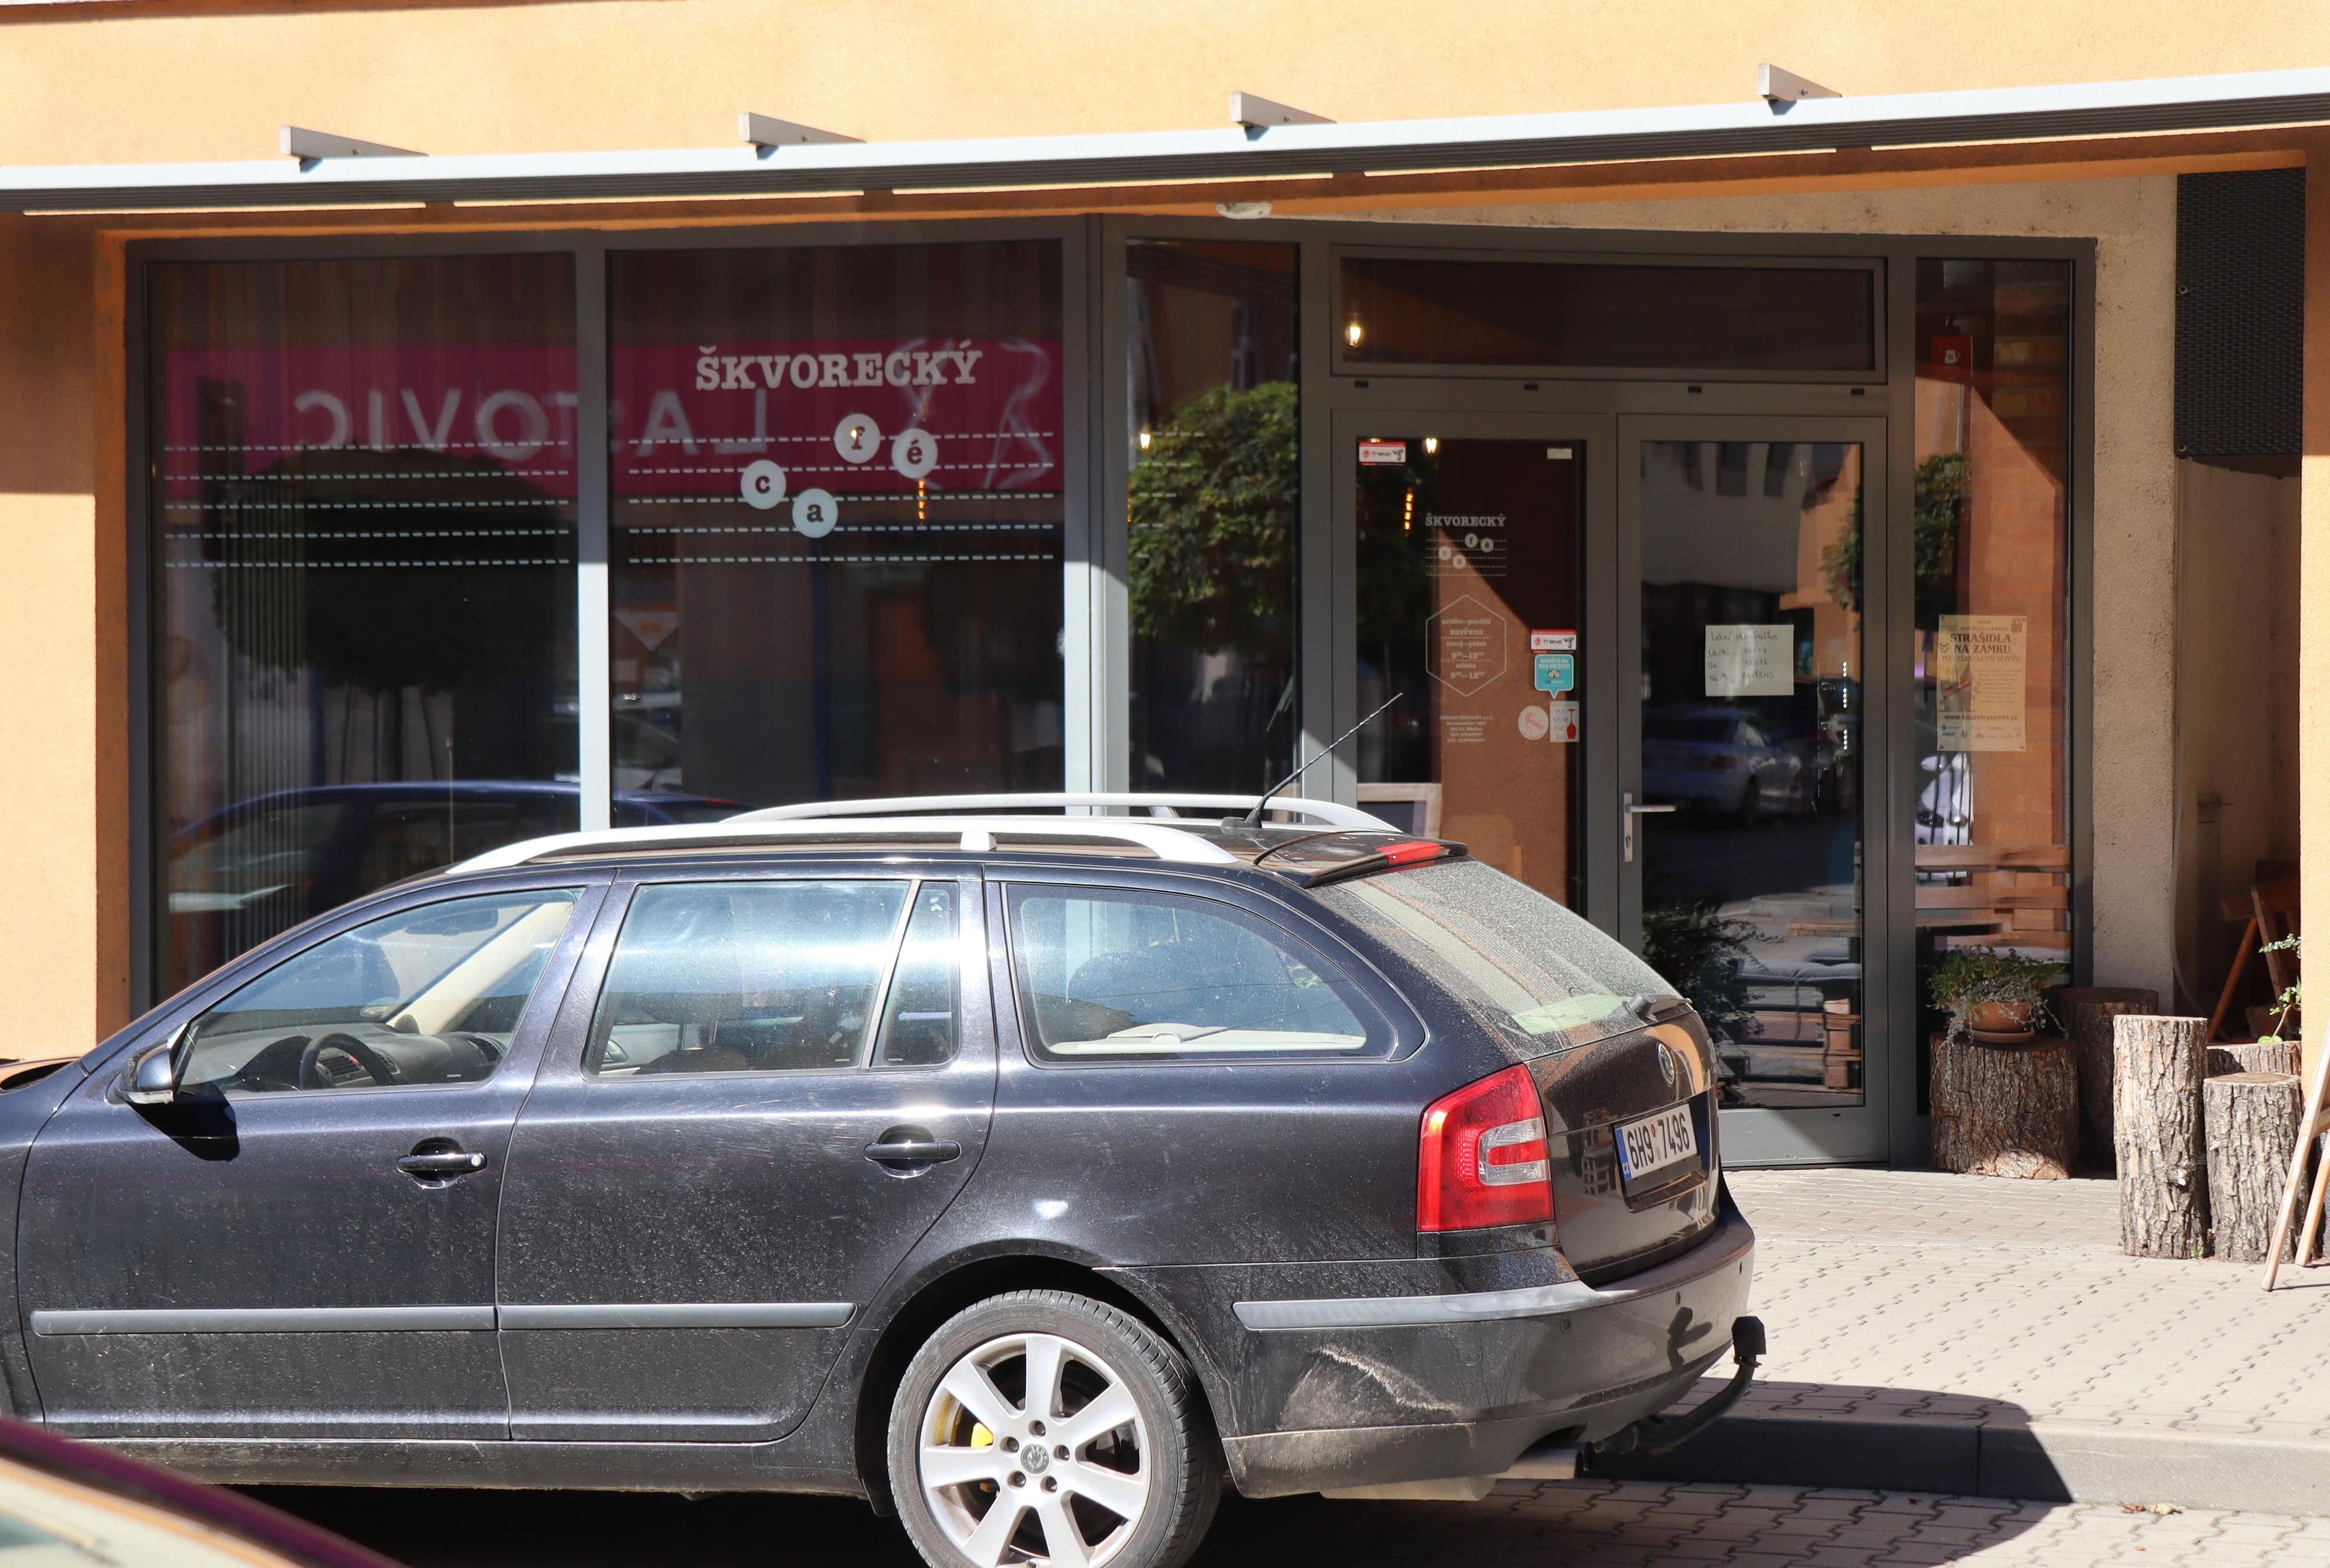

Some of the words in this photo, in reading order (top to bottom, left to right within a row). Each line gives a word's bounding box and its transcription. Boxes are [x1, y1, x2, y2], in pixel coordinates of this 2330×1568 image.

[696, 341, 983, 391] ŠKVORECKÝ
[1425, 513, 1506, 527] ŠKVORECKÝ
[1449, 628, 1484, 636] zavřeno
[1711, 630, 1732, 641] Letní
[1950, 632, 2011, 642] STRAŠIDLA
[1954, 644, 1969, 653] NA
[1973, 642, 2011, 654] ZÁMKU
[1944, 713, 2018, 722] www.kouzelnyzamek.cz
[1627, 1125, 1654, 1170] 6H9
[1657, 1113, 1690, 1159] 7496
[1622, 1162, 1630, 1175] CZ
